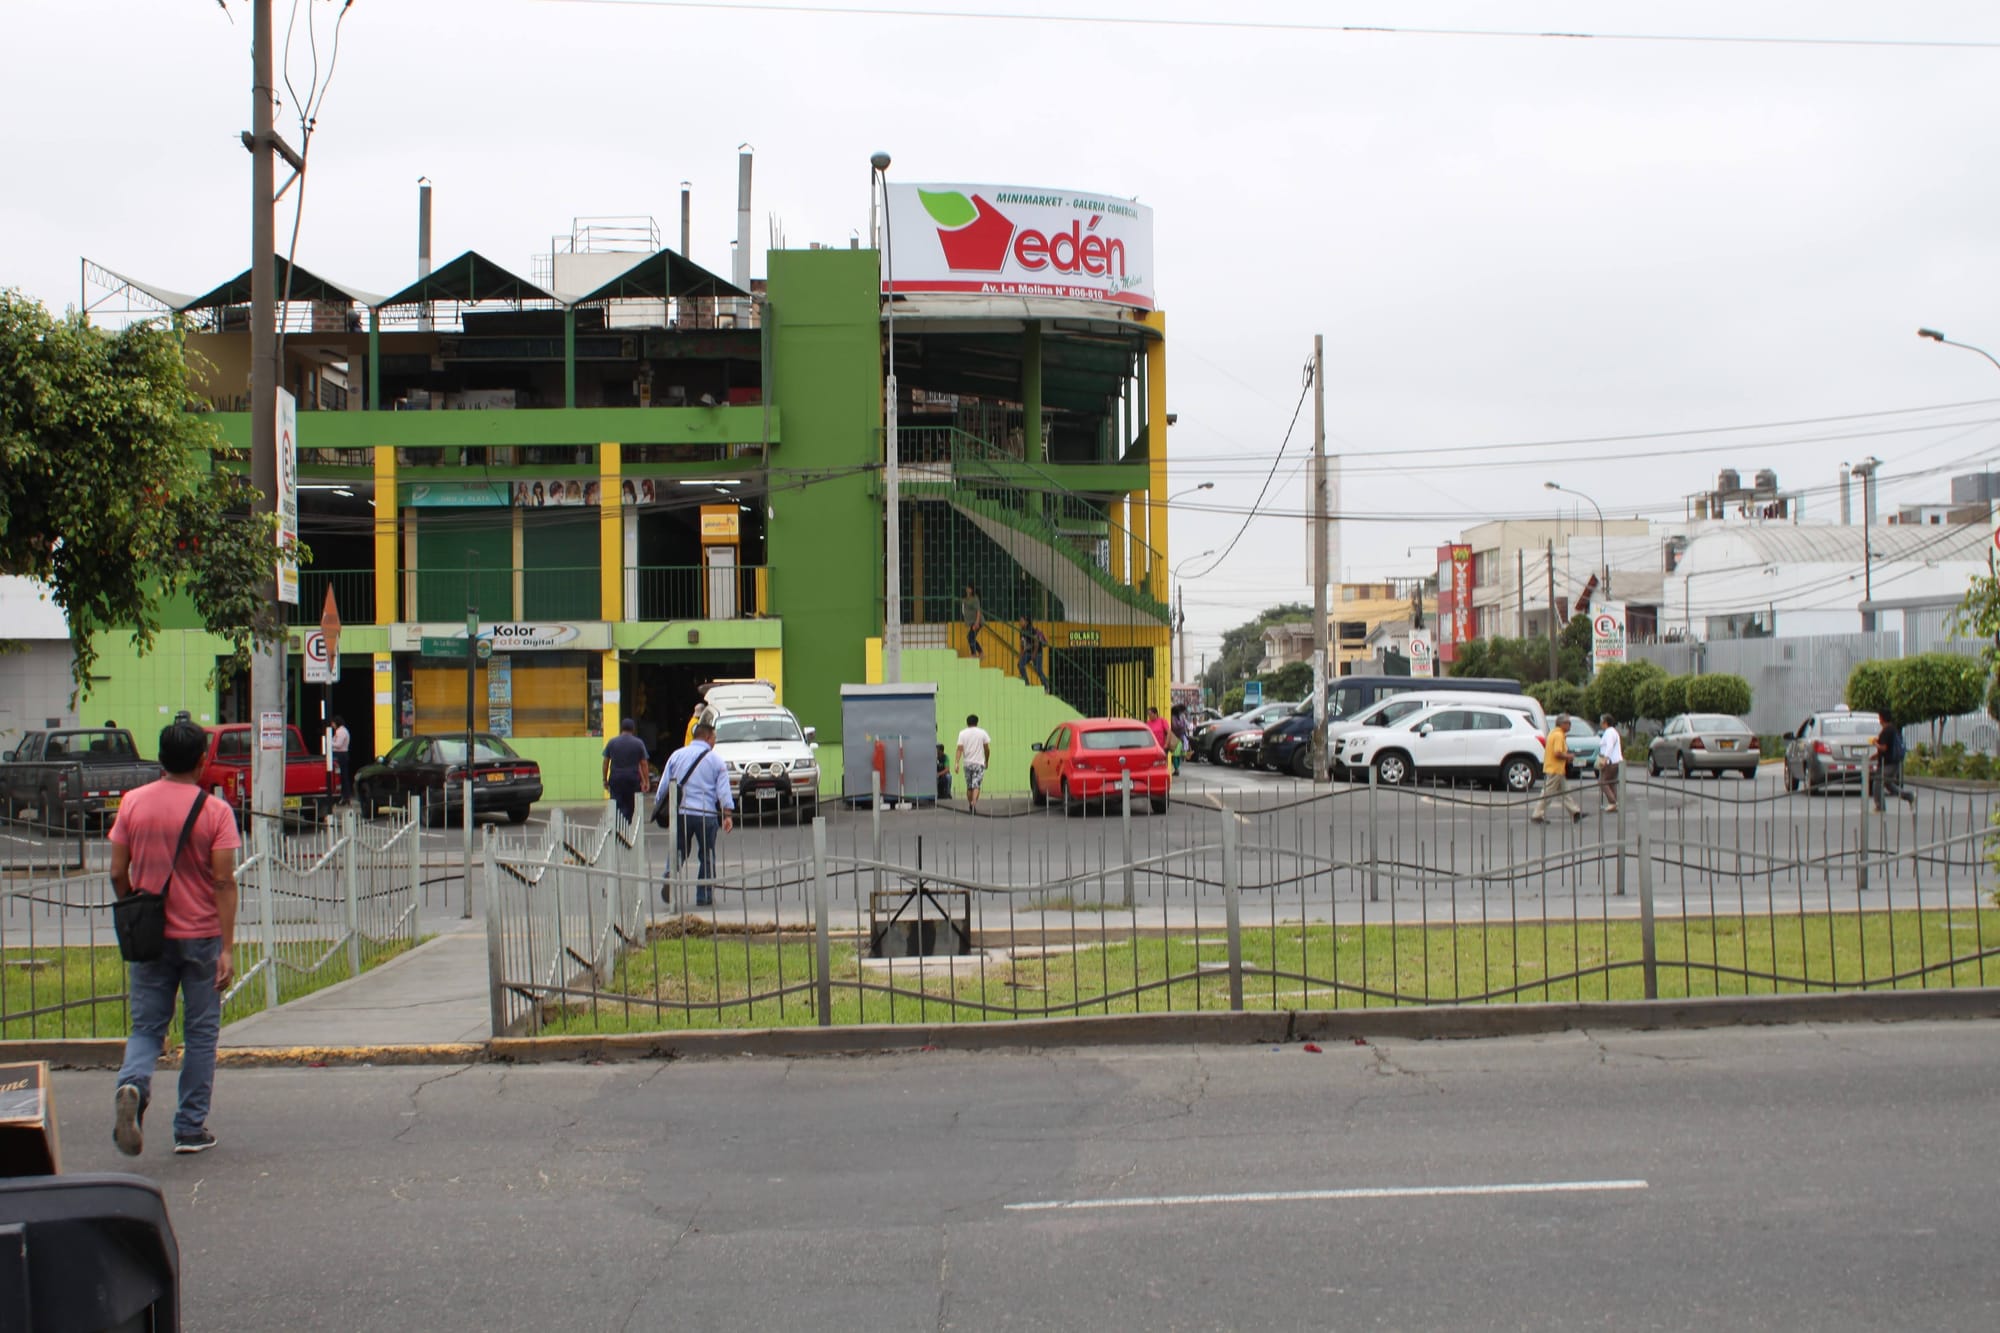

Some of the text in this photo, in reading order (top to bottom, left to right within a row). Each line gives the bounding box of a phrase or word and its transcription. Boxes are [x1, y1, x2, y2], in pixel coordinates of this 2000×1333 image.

[996, 192, 1063, 207] MINIMARKET
[1073, 199, 1105, 212] GALERIA
[1107, 203, 1139, 219] COMERCIAL
[1014, 214, 1126, 278] edén
[981, 283, 999, 293] Av.
[1001, 284, 1015, 293] La
[1018, 285, 1053, 295] Molina
[493, 625, 536, 637] Kolor
[1601, 620, 1610, 632] E
[315, 638, 327, 657] E
[522, 639, 554, 648] Digital
